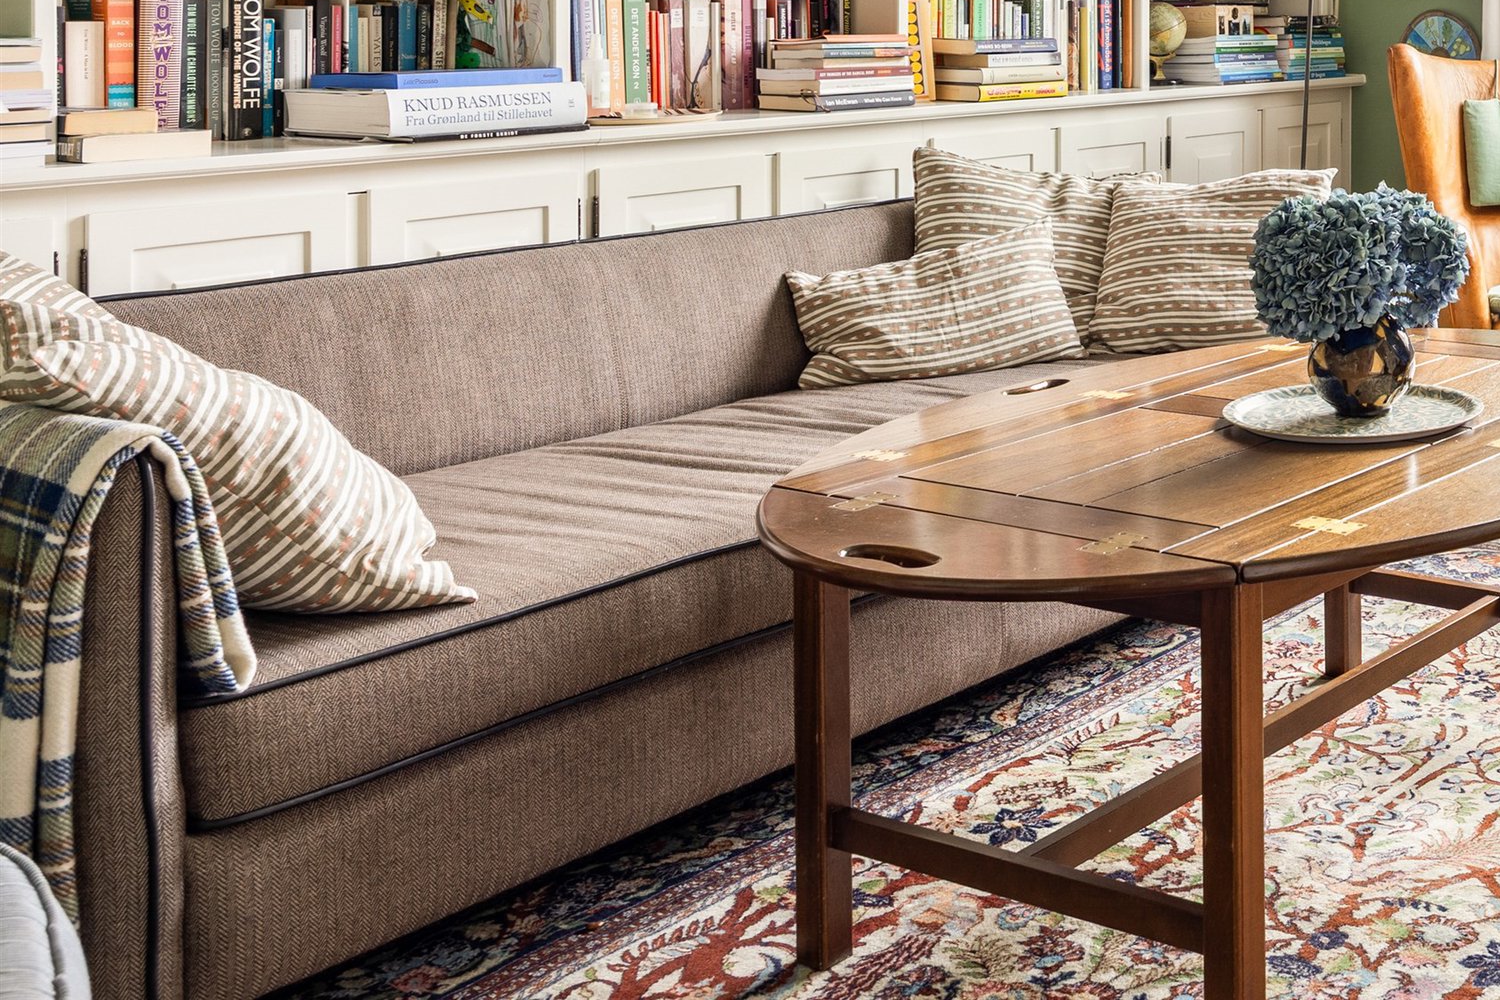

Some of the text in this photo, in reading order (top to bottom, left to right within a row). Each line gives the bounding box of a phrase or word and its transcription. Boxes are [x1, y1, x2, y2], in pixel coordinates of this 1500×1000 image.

[111, 19, 130, 27] BACK
[233, 3, 242, 40] BONFIRE
[318, 15, 329, 56] Virginia Woolf
[108, 41, 134, 49] BLOOD
[233, 41, 242, 53] OF
[372, 37, 382, 68] YATES
[630, 7, 641, 90] DET ANDET KØN 2
[1103, 18, 1111, 73] STATSKUNDSKAB
[186, 3, 198, 124] TOM WOLFE AM CHARLOTTE SIMMONS
[210, 1, 221, 121] TOM WOLFE HOOKING UP
[233, 54, 242, 70] THE
[242, 37, 262, 110] WOLFE
[112, 100, 130, 108] TOM
[232, 72, 242, 109] VANITIES
[403, 91, 552, 113] KNUD RASMUSSEN
[825, 98, 859, 107] Ian McEwan
[405, 108, 553, 127] Fra Grønland til Stillehavet
